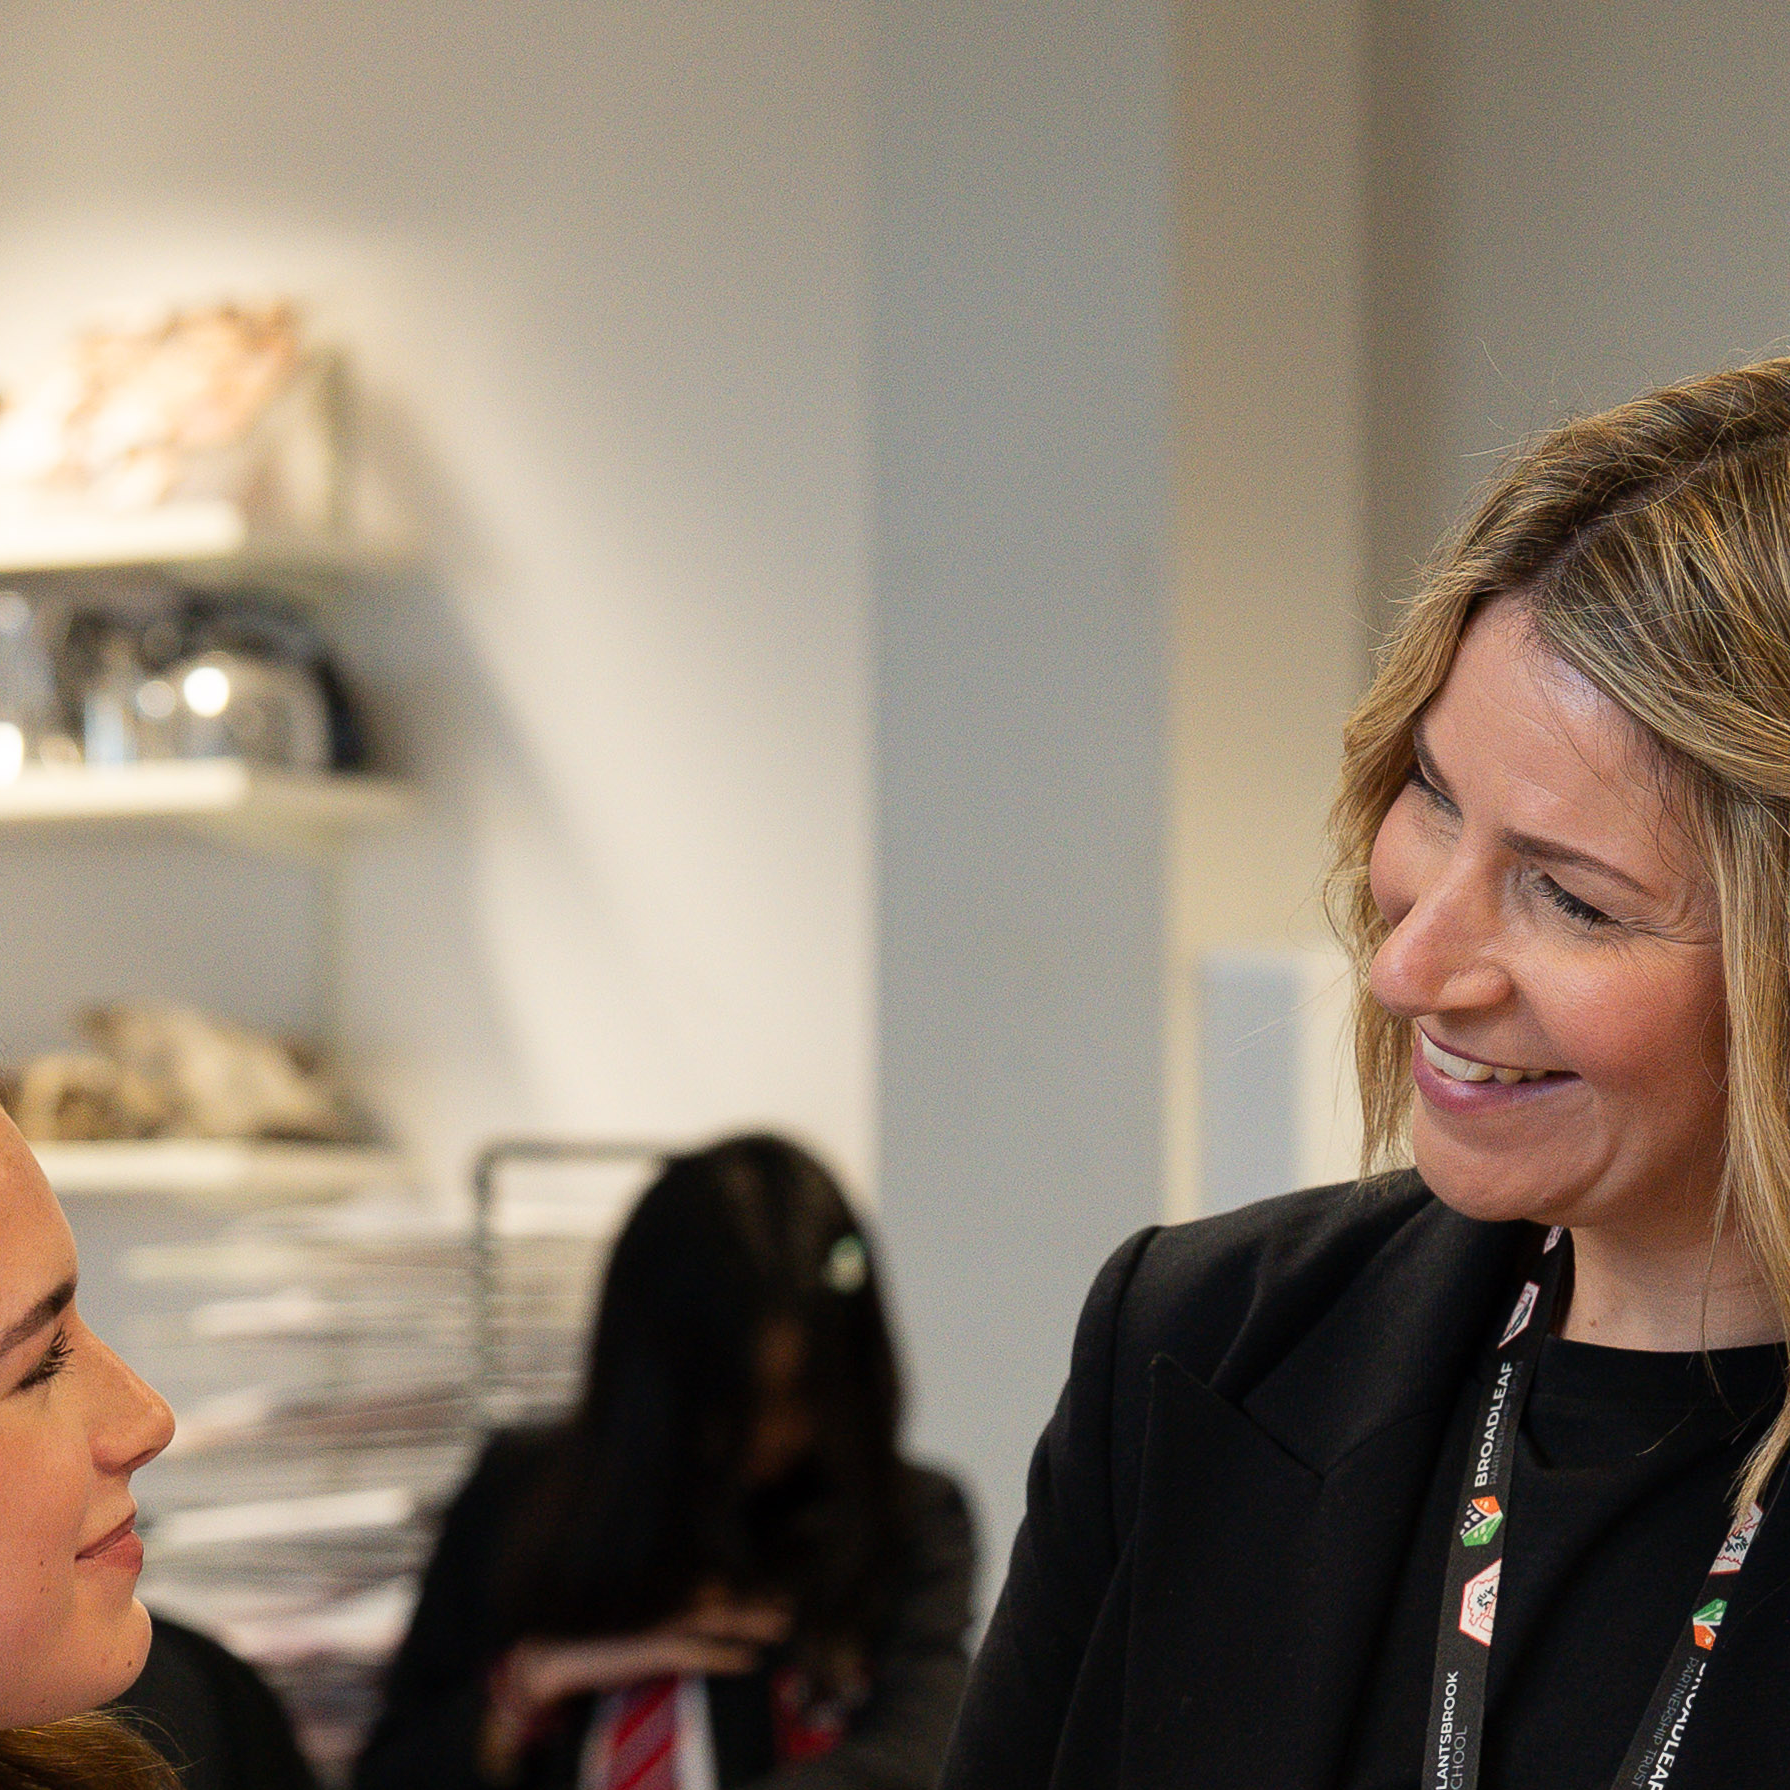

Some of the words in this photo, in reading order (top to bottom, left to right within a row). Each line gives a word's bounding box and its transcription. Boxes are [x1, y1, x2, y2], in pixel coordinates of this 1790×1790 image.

[1474, 1362, 1513, 1488] BROADLEAF
[1652, 1656, 1700, 1746] PARTNERSHIP
[1631, 1748, 1658, 1790] TRUST
